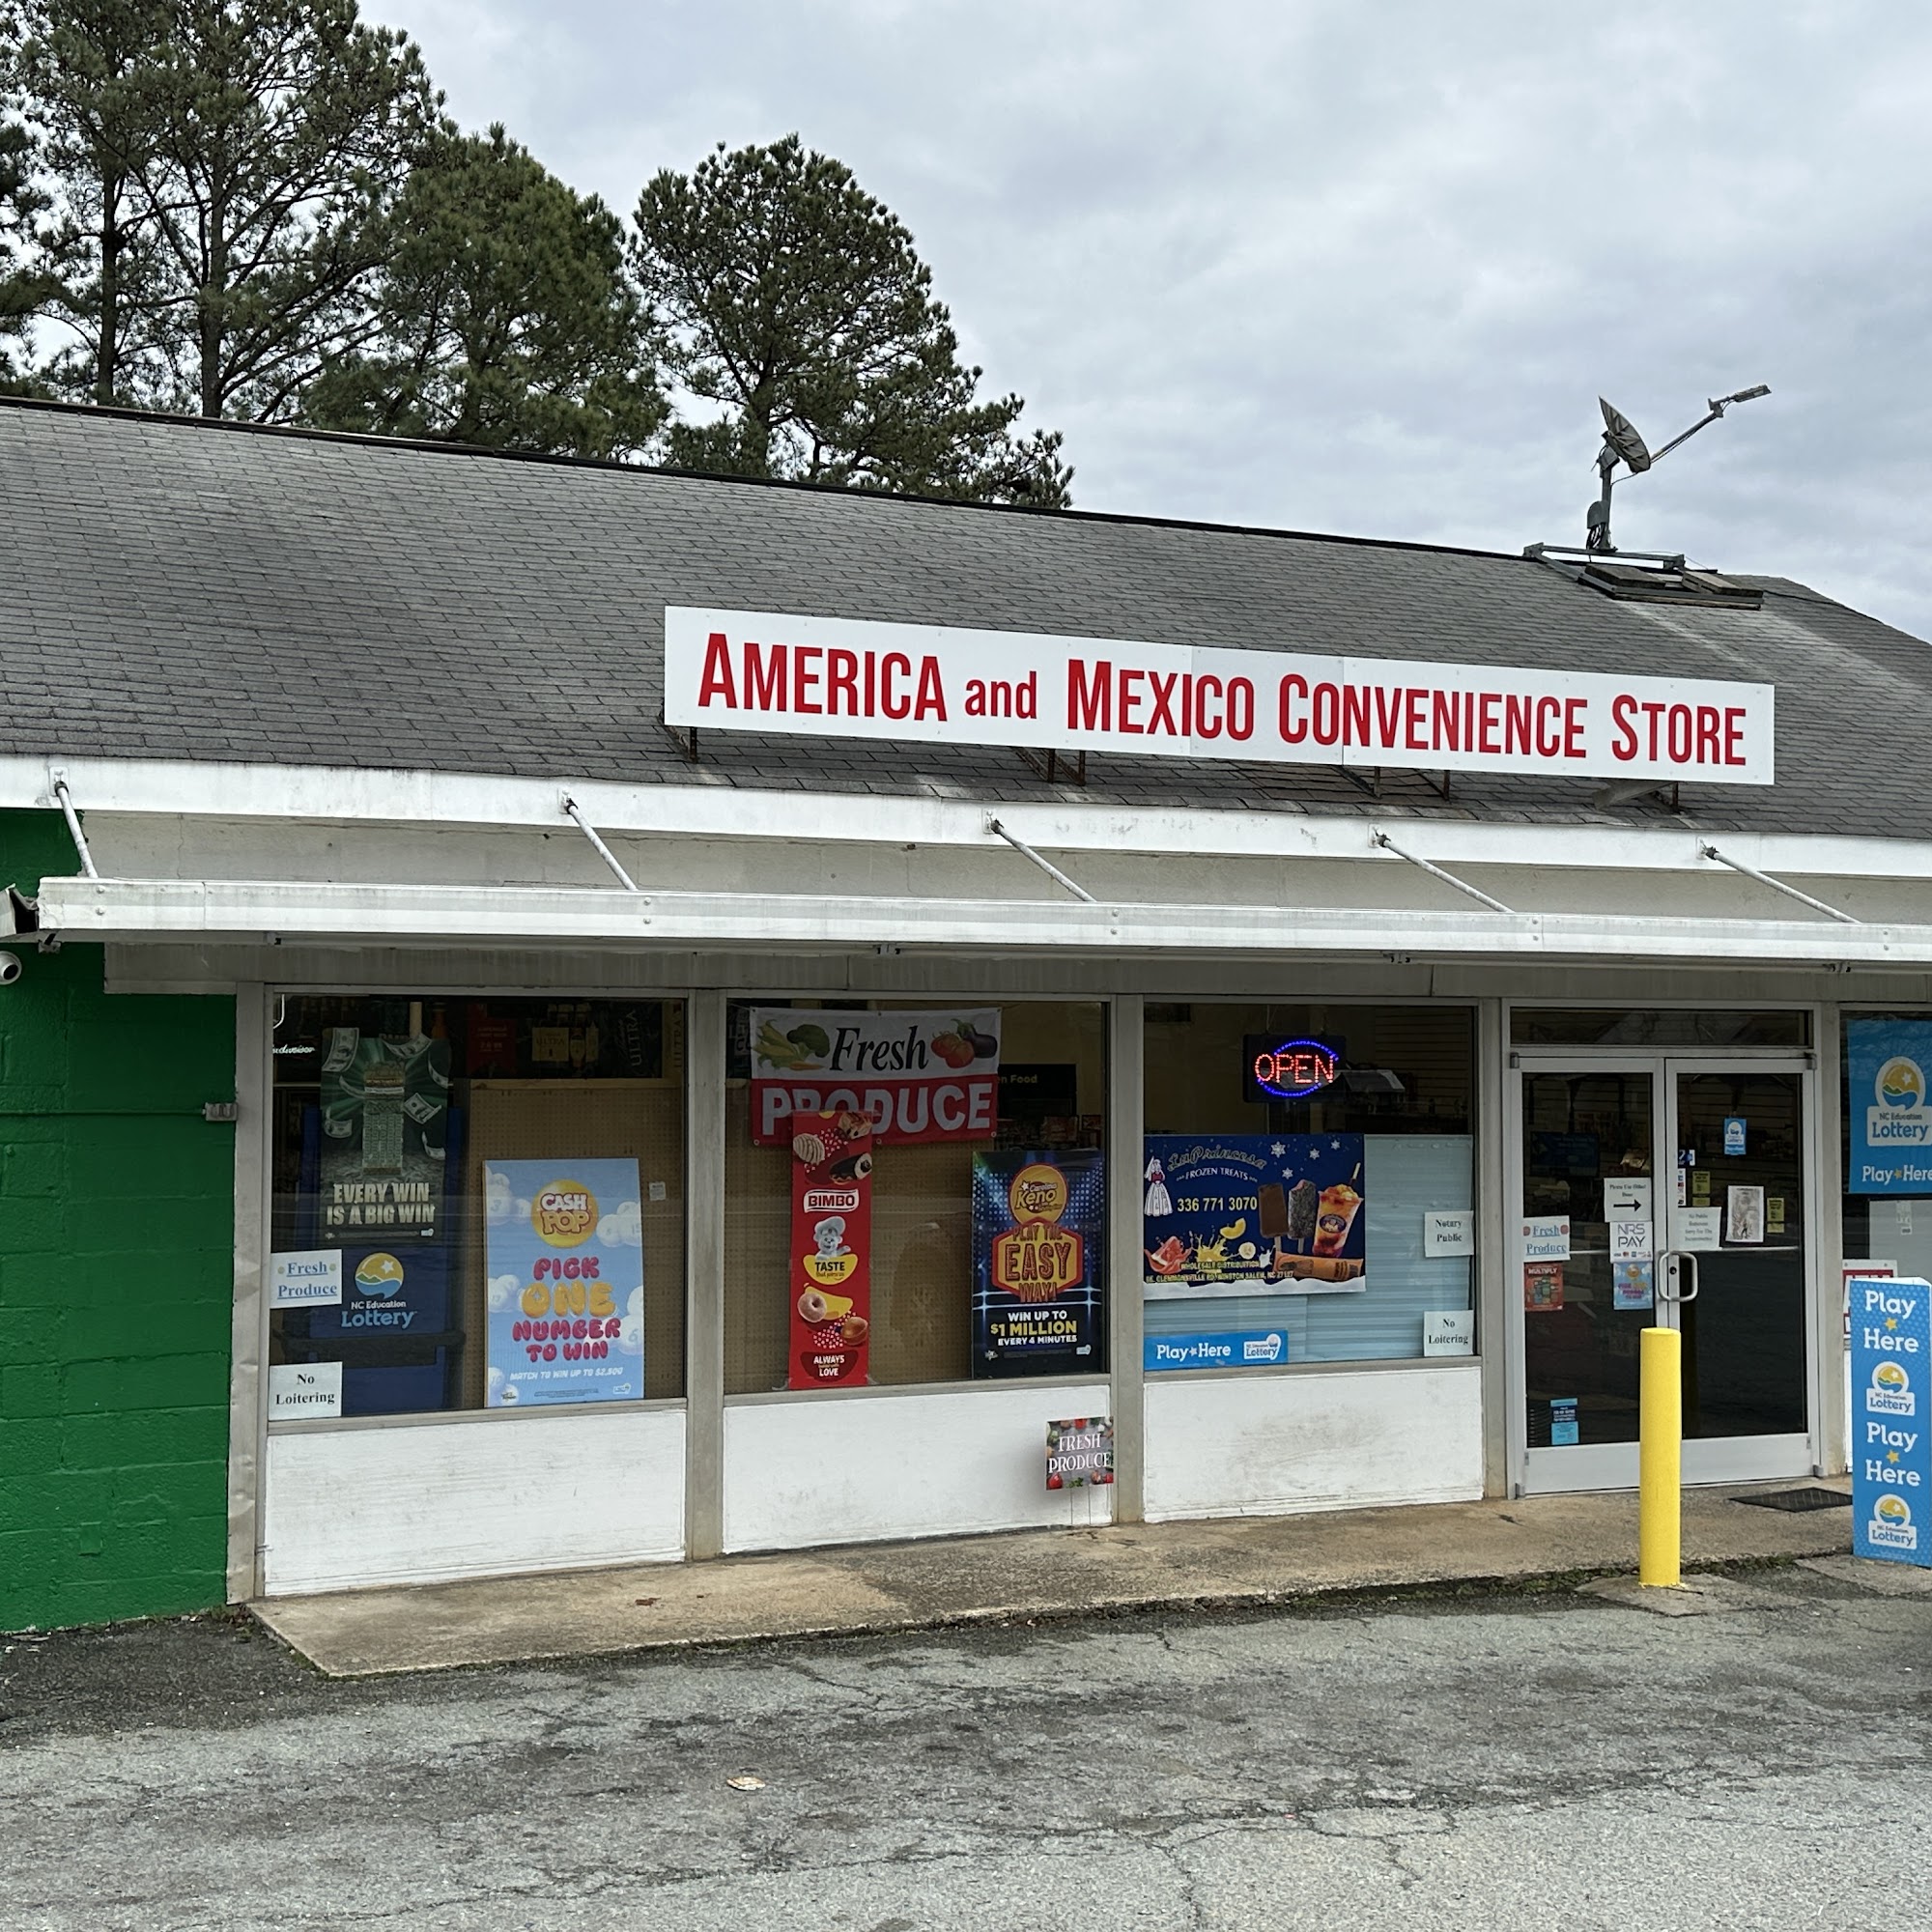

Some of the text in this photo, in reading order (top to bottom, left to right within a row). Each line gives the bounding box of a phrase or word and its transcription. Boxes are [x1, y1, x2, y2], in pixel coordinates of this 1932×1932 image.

[697, 632, 1747, 766] AMERICA and MEXICO CONVENIENCE STORE
[830, 1025, 929, 1071] Fresh
[1254, 1053, 1335, 1084] OPEN
[1009, 1073, 1037, 1084] Food
[1890, 1112, 1922, 1121] Education
[1872, 1122, 1929, 1142] Lottery
[1185, 1167, 1248, 1180] FROZEN TREATS
[1861, 1165, 1894, 1186] Play
[333, 1182, 430, 1204] EVERY WIN
[809, 1195, 855, 1207] BIMBO
[1015, 1189, 1057, 1209] Keno
[540, 1192, 588, 1212] CASH
[1177, 1196, 1258, 1212] 336 771 3070
[327, 1204, 435, 1226] IS A BIG WIN
[540, 1209, 590, 1236] POP
[1435, 1219, 1463, 1229] Notary
[1532, 1225, 1560, 1236] Fresh
[1617, 1223, 1646, 1235] NRS
[1436, 1234, 1463, 1242] Public
[1617, 1236, 1646, 1248] PAY
[1526, 1243, 1567, 1255] Produce
[286, 1262, 328, 1276] Fresh
[533, 1257, 600, 1281] PICK
[815, 1262, 845, 1271] TASTE
[1005, 1242, 1071, 1281] EASY
[277, 1284, 338, 1297] Produce
[1018, 1281, 1057, 1303] WAY!
[351, 1300, 407, 1310] NC Education
[522, 1280, 616, 1319] ONE
[1864, 1290, 1917, 1320] Play
[341, 1310, 414, 1329] Lottery
[1007, 1310, 1067, 1322] WIN UP TO
[1442, 1319, 1455, 1328] No
[512, 1318, 621, 1342] NUMBER
[990, 1321, 1077, 1337] $1 MILLION
[997, 1337, 1028, 1347] EVERY
[1037, 1335, 1077, 1344] MINUTES
[1428, 1335, 1468, 1345] Loitering
[1863, 1327, 1919, 1353] Here
[526, 1341, 609, 1363] TO WIN
[813, 1354, 845, 1364] ALWAYS
[1156, 1343, 1231, 1362] Play Here
[1246, 1348, 1278, 1358] Lottery
[297, 1374, 315, 1385] No
[510, 1372, 538, 1381] MATCH
[540, 1371, 552, 1379] TO
[553, 1370, 568, 1378] WIN
[570, 1369, 582, 1378] UP
[583, 1368, 593, 1377] TO
[818, 1367, 839, 1377] LOVE
[275, 1392, 335, 1406] Loitering
[1870, 1397, 1912, 1413] Lottery
[1058, 1433, 1101, 1453] FRESH
[1866, 1421, 1918, 1453] Play
[1048, 1451, 1110, 1474] PRODUCE
[1865, 1459, 1921, 1487] Here
[1871, 1530, 1914, 1548] Lottery
